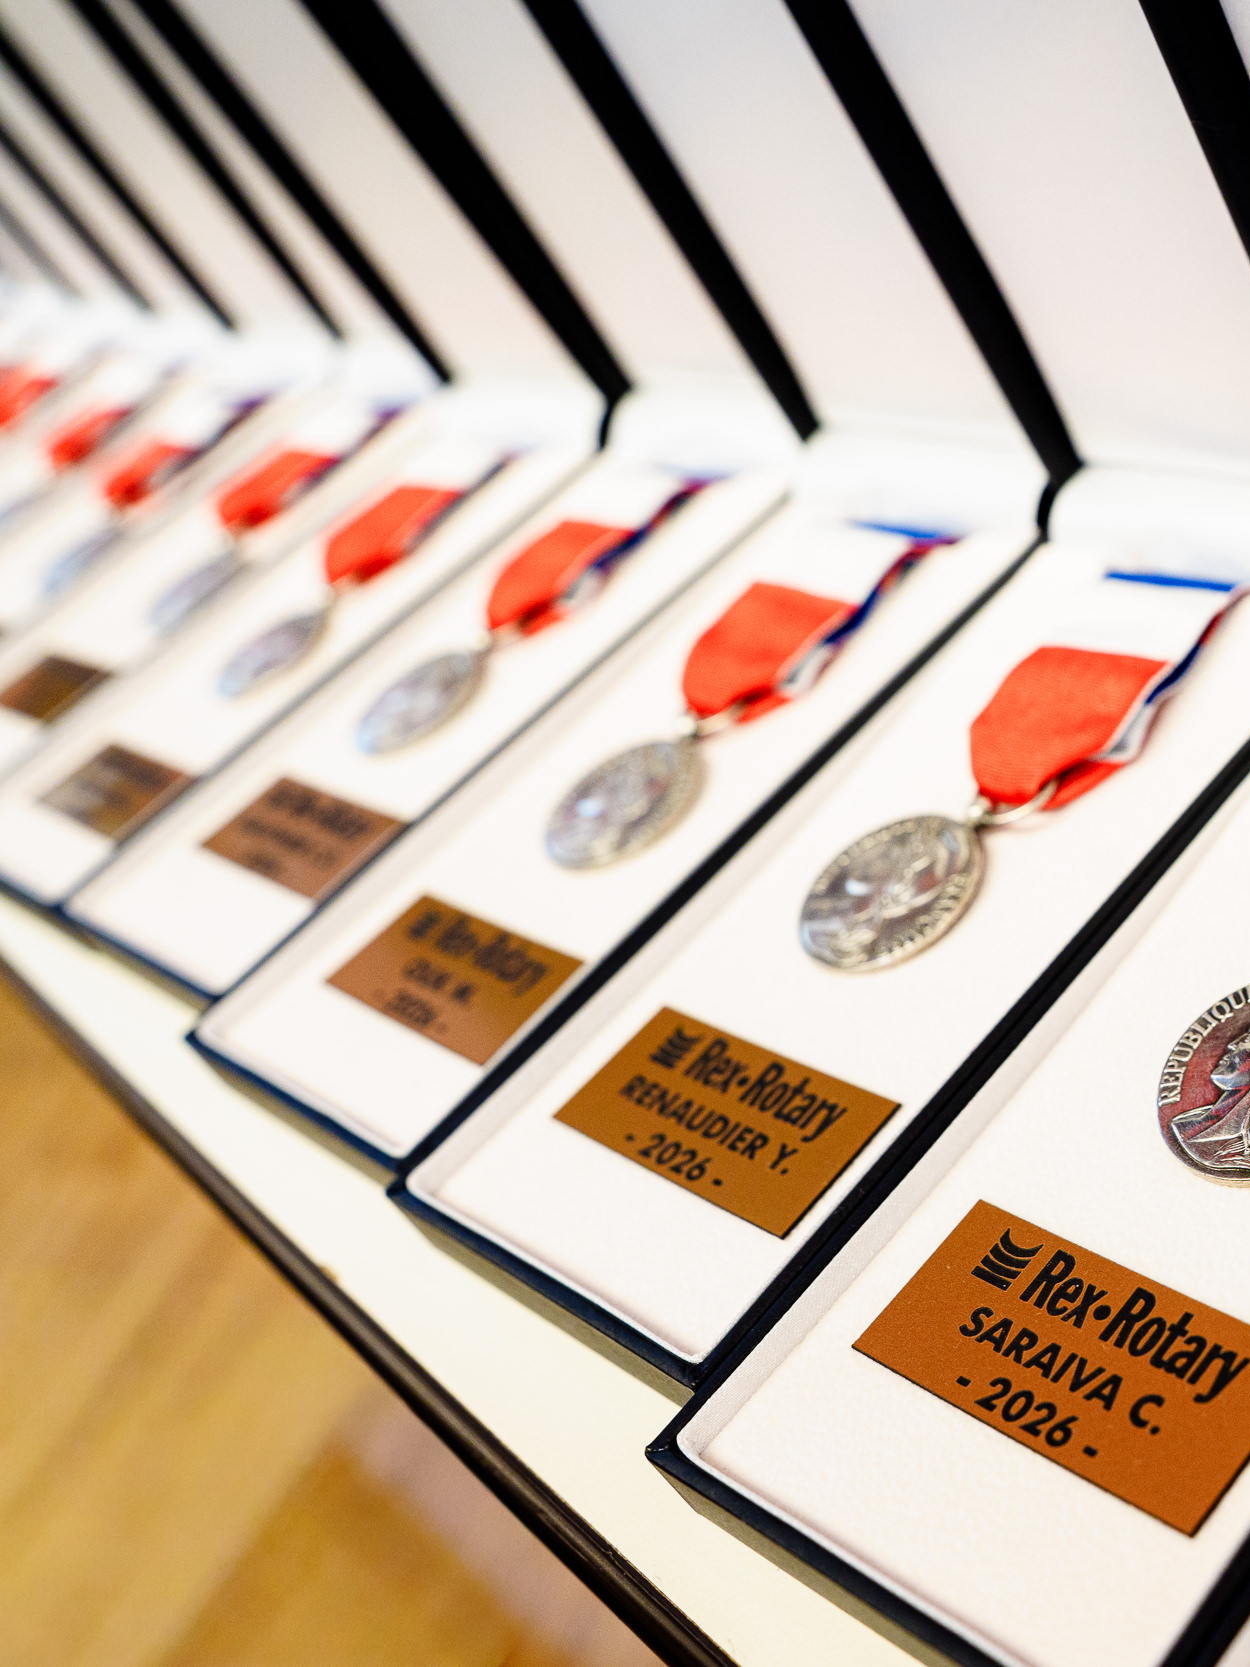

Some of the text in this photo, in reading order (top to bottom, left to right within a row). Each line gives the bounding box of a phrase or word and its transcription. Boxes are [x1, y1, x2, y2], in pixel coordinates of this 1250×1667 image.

[617, 1074, 799, 1176] RENAUDIER Y.
[638, 1132, 712, 1182] 2026
[958, 1305, 1166, 1436] SARAIVA C.
[974, 1376, 1079, 1449] 2026
